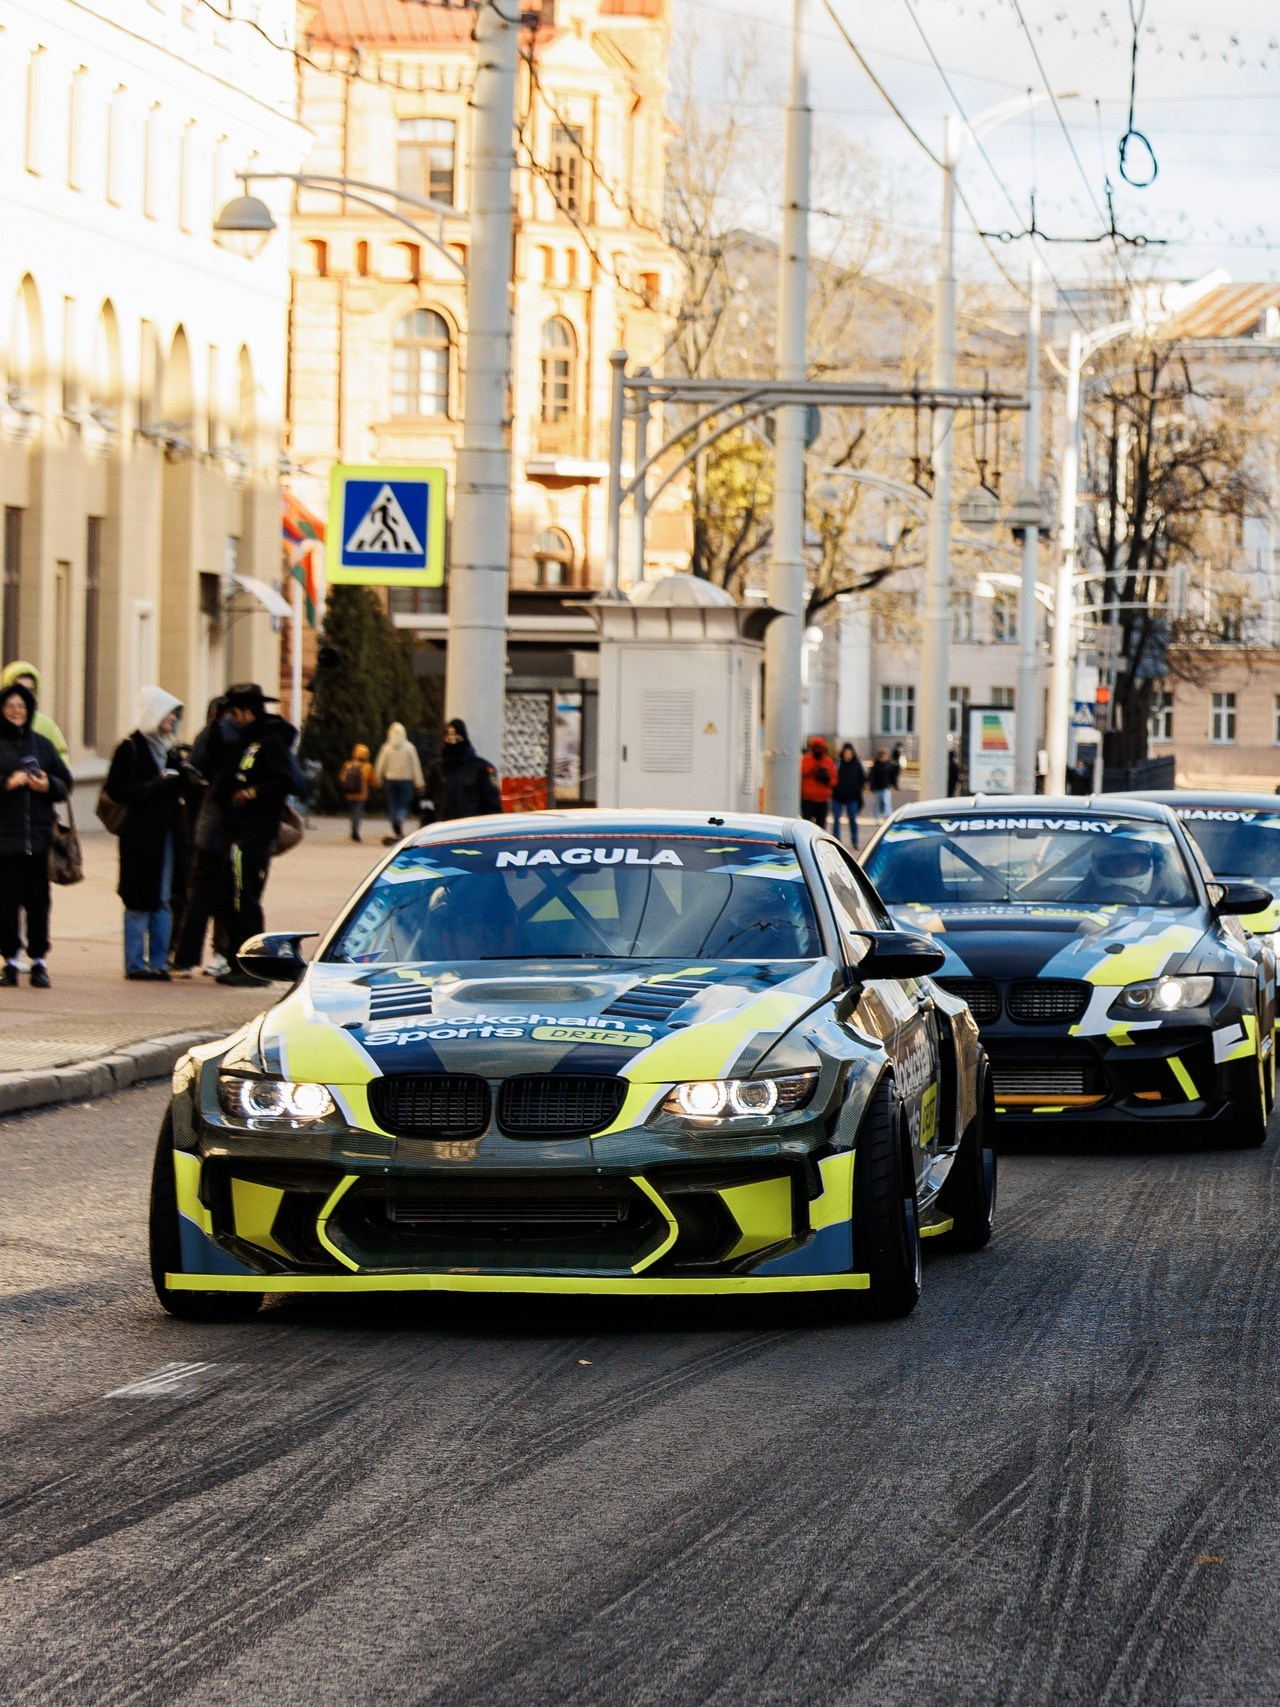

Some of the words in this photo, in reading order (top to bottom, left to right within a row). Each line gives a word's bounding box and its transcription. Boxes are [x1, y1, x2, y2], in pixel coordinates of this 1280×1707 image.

[940, 818, 1119, 833] VISHNEVSKY
[495, 848, 684, 868] NAGULA
[368, 1014, 626, 1033] Blockchain
[362, 1026, 524, 1047] Sports
[550, 1029, 637, 1043] DRIFT
